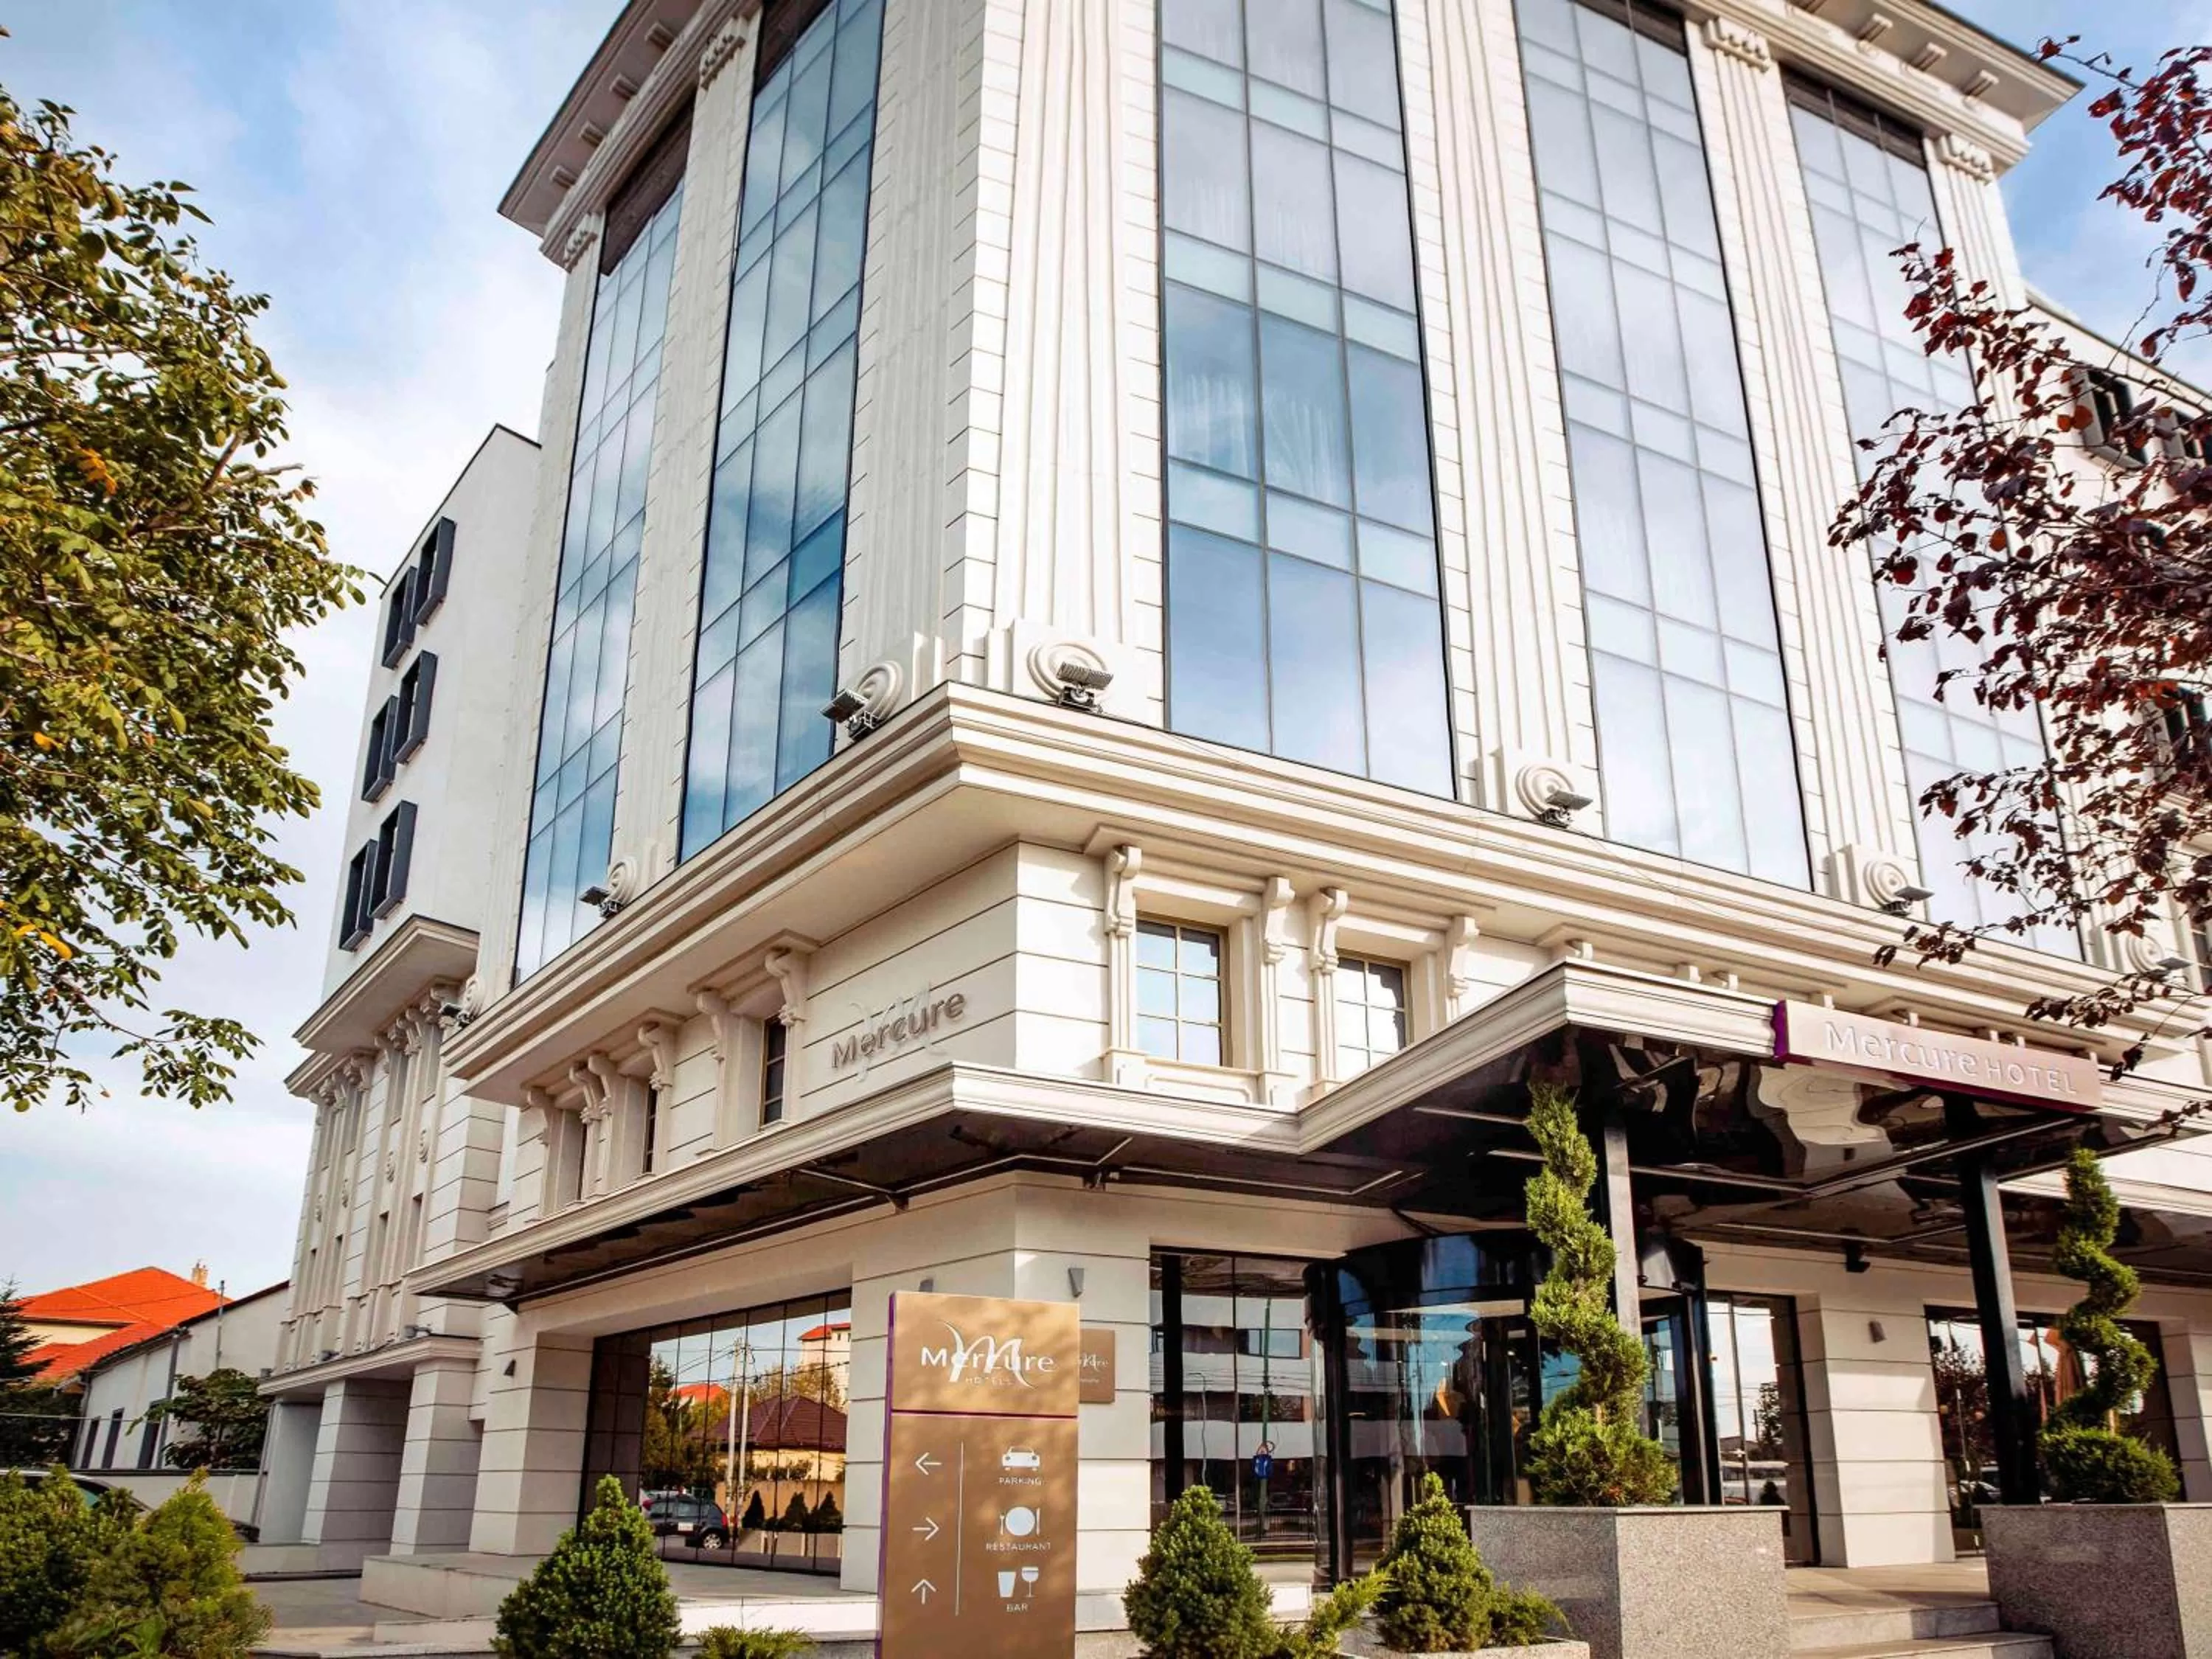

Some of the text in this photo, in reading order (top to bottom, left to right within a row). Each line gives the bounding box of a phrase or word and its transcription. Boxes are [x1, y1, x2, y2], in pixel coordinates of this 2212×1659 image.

[832, 993, 965, 1068] Mercure
[1824, 1021, 2077, 1095] Mercure HOTEL
[998, 1477, 1043, 1486] PARKING
[986, 1542, 1051, 1552] RESTAURANT
[1006, 1603, 1028, 1613] BAR
